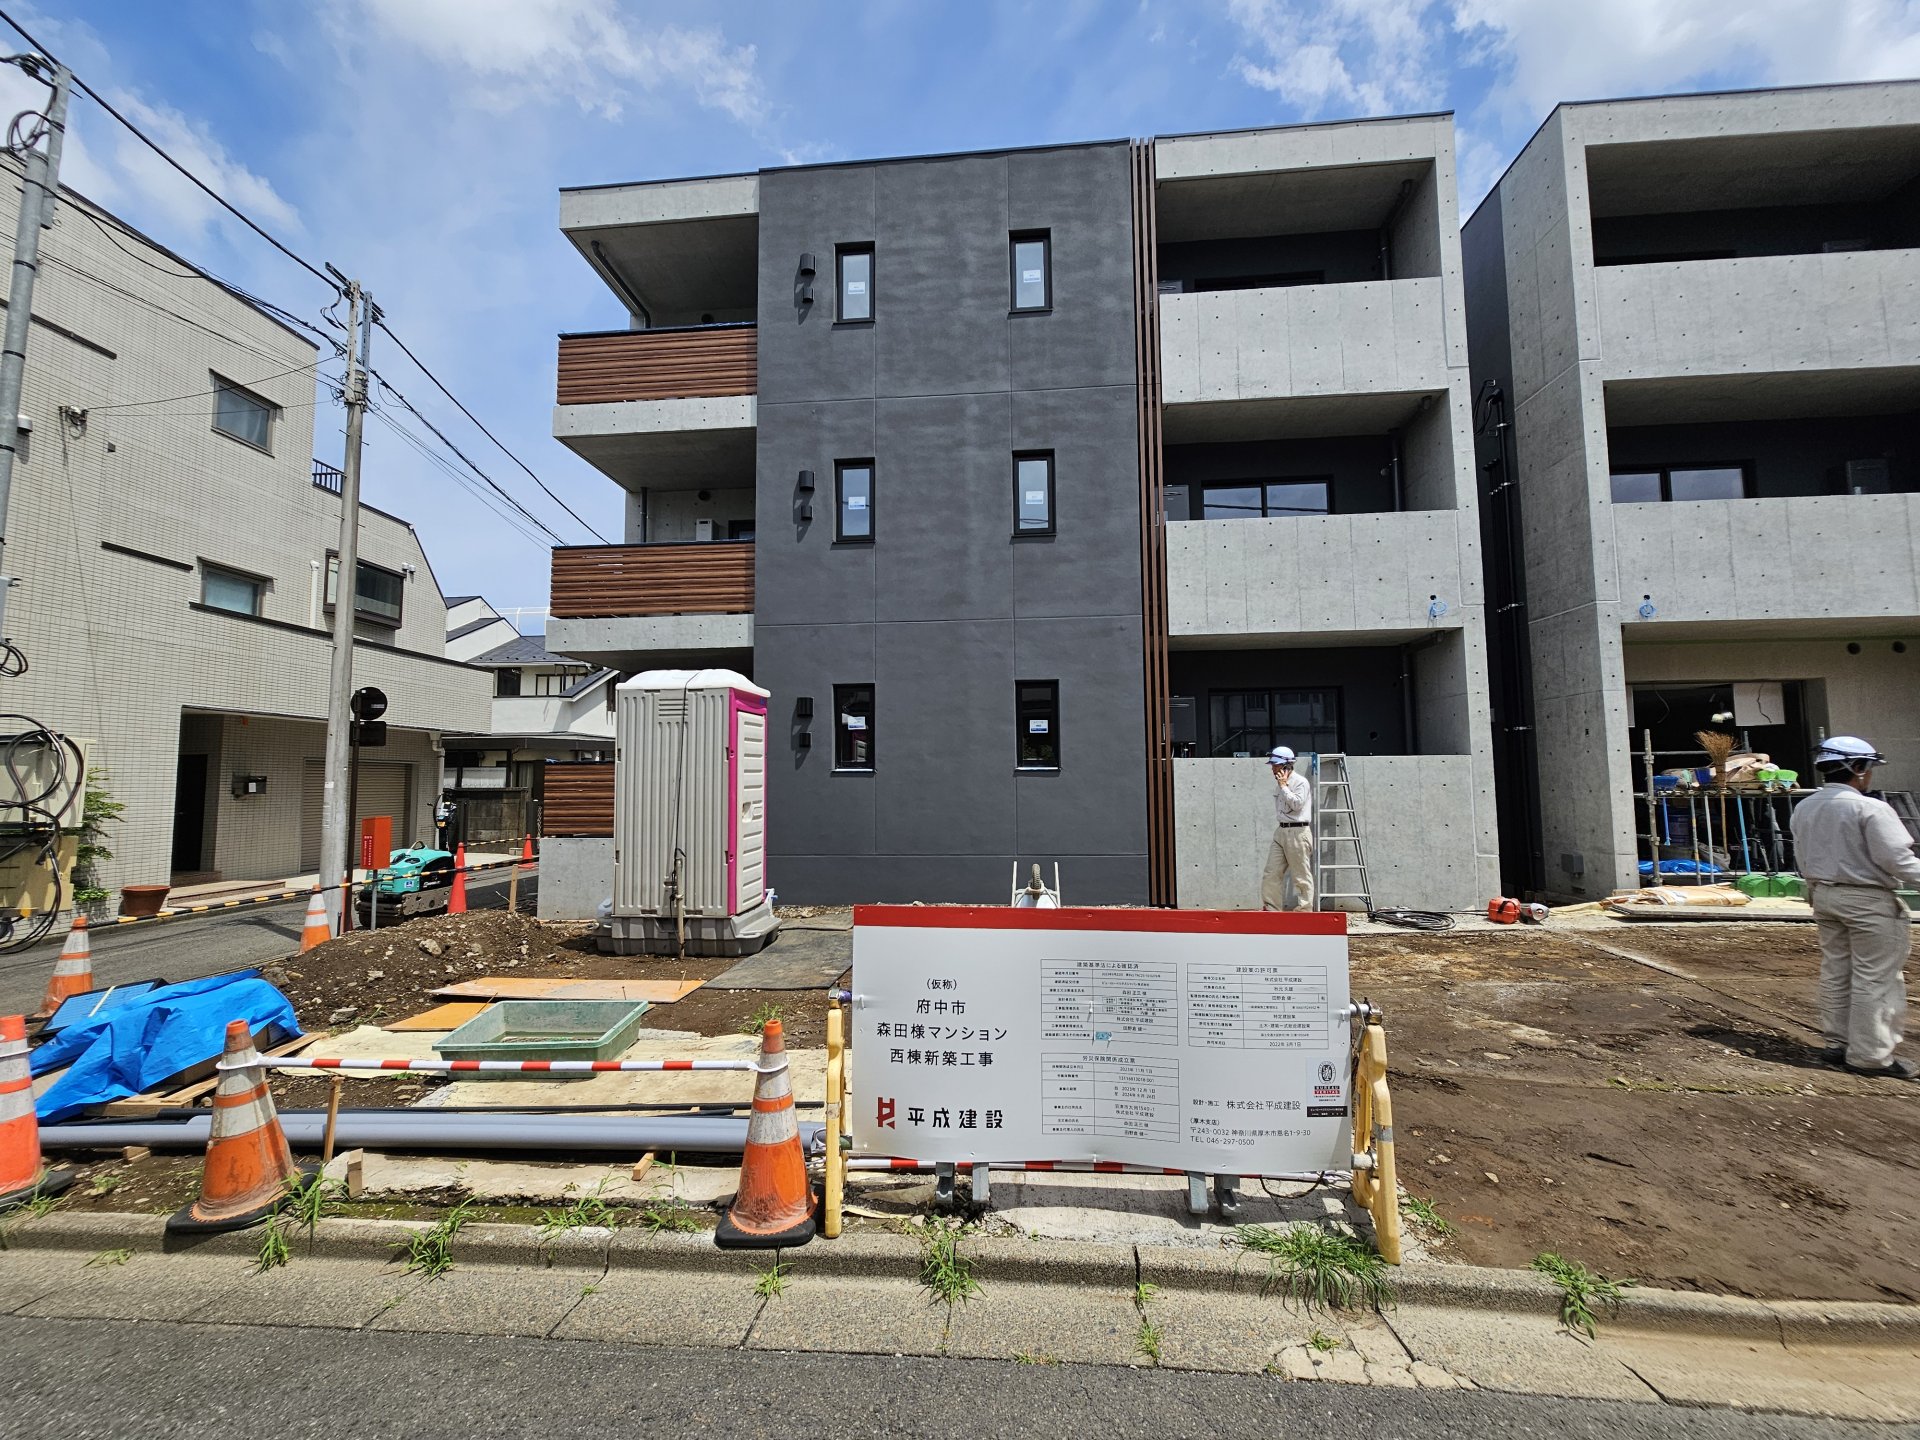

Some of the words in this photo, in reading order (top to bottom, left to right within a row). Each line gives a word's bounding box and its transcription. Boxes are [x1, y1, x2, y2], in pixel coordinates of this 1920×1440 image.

[916, 999, 966, 1015] 府中市
[877, 1022, 1007, 1041] 森田様マンション
[890, 1048, 994, 1066] 西棟新築工事
[908, 1107, 1003, 1129] 平成建設
[1207, 1137, 1255, 1145] 046-297-0500
